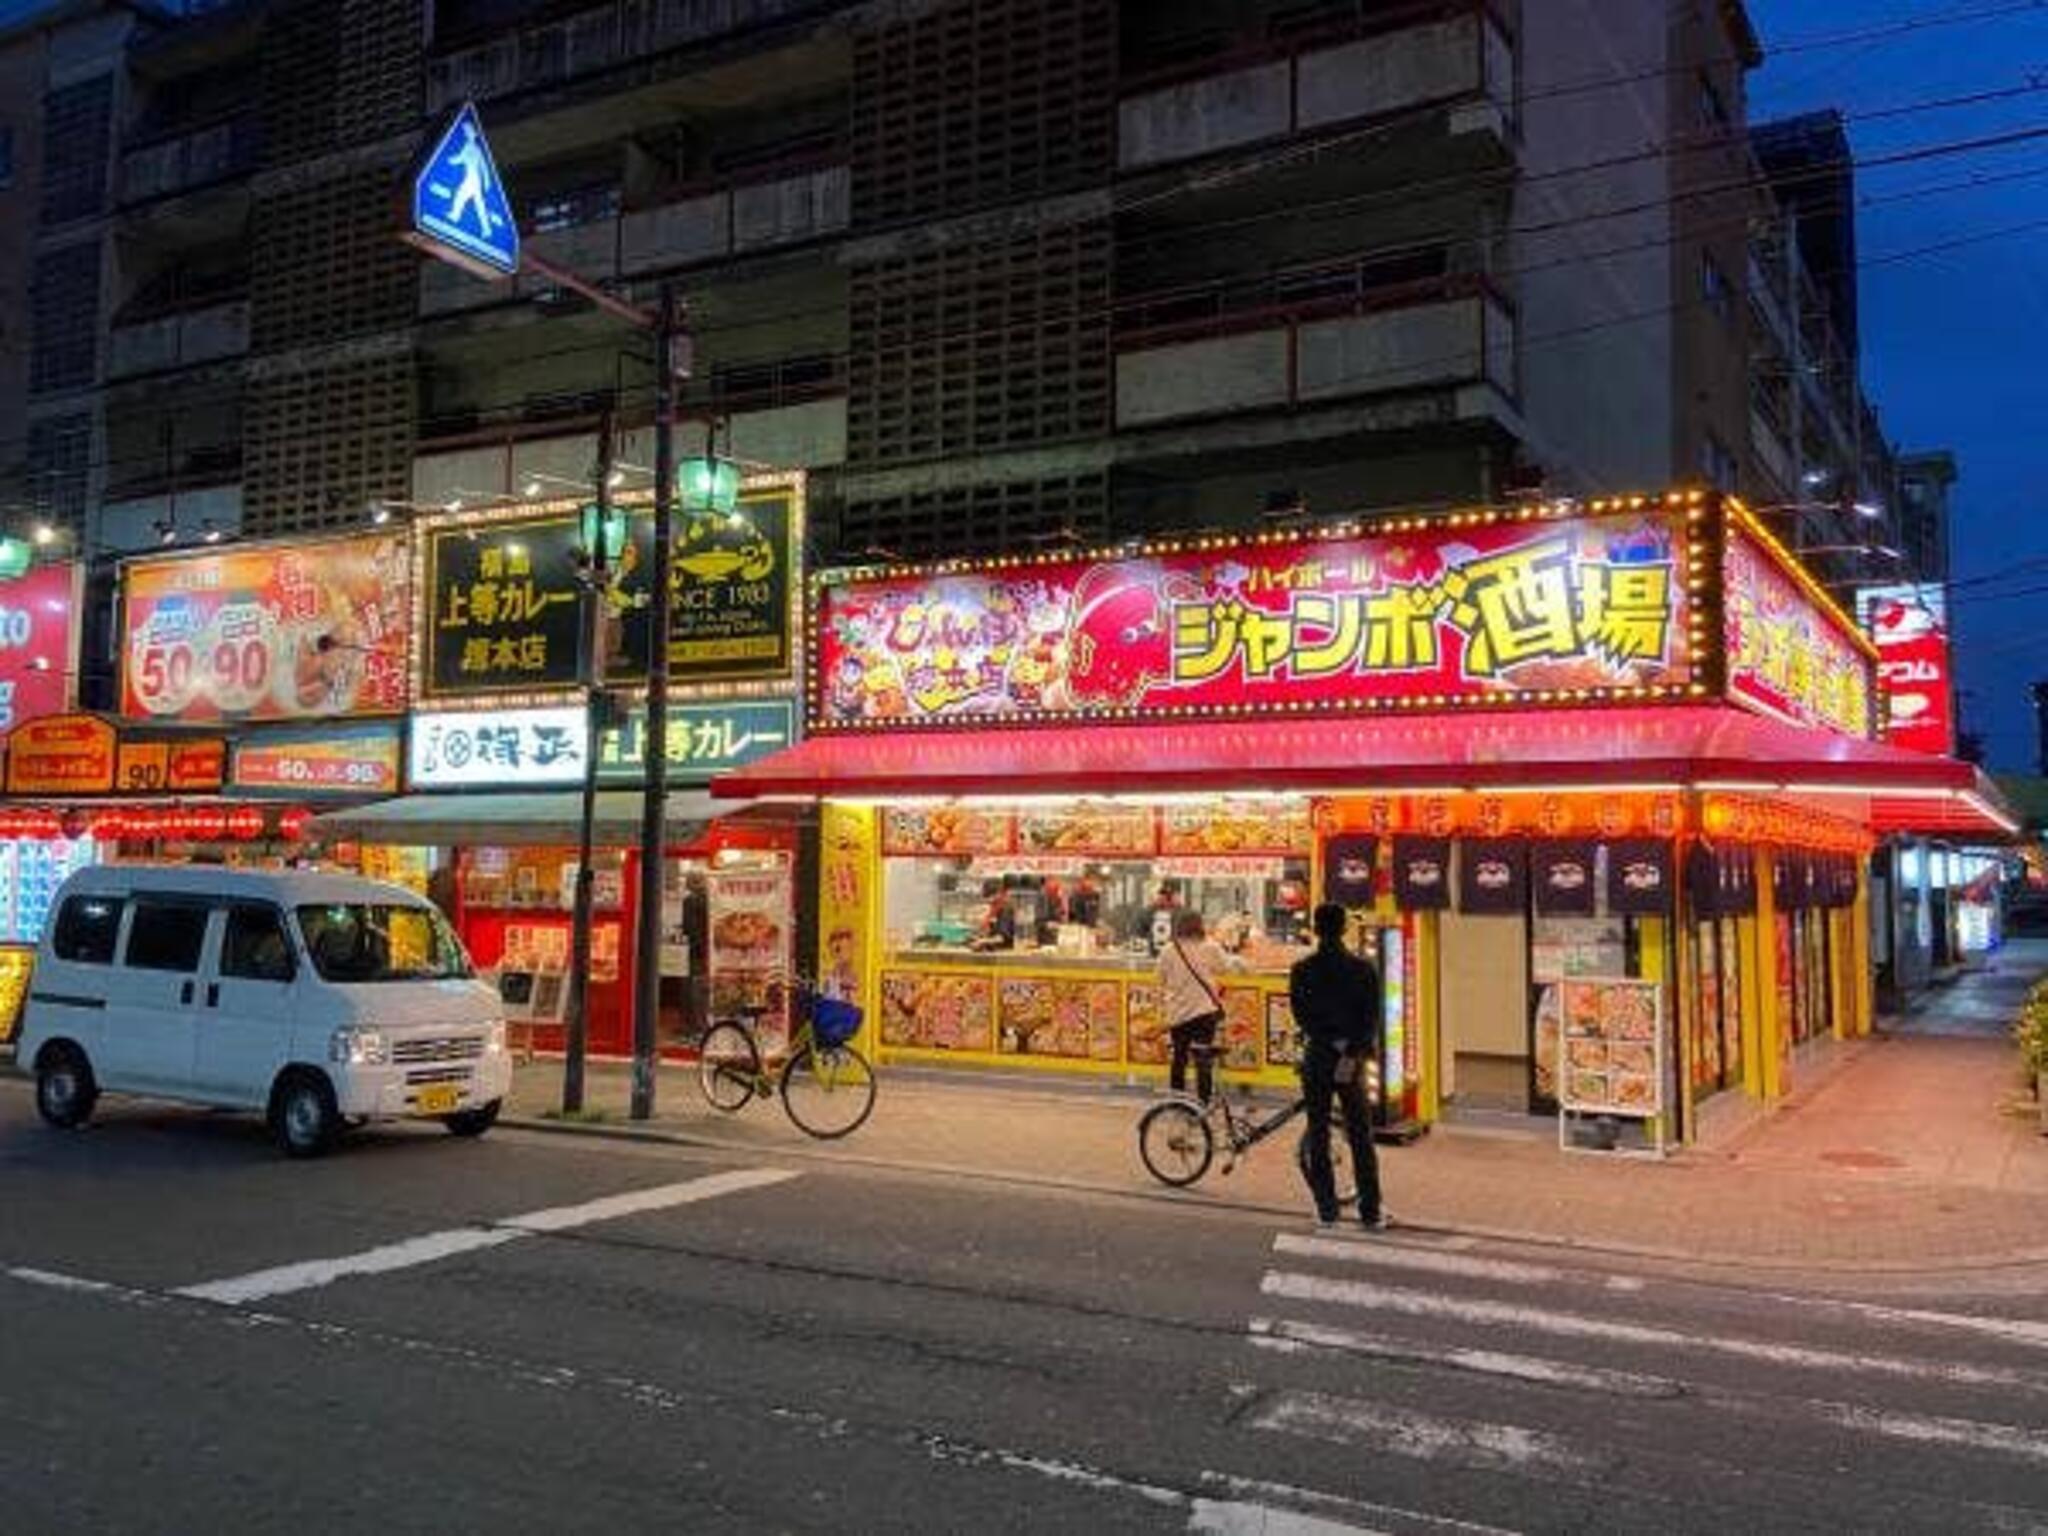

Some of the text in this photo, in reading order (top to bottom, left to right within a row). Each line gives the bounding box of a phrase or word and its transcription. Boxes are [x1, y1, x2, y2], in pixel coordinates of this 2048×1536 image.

[1248, 557, 1376, 593] ハイボール
[440, 580, 576, 628] 上等カレー
[1174, 533, 1669, 679] ジャンボ酒場
[214, 640, 268, 690] 90
